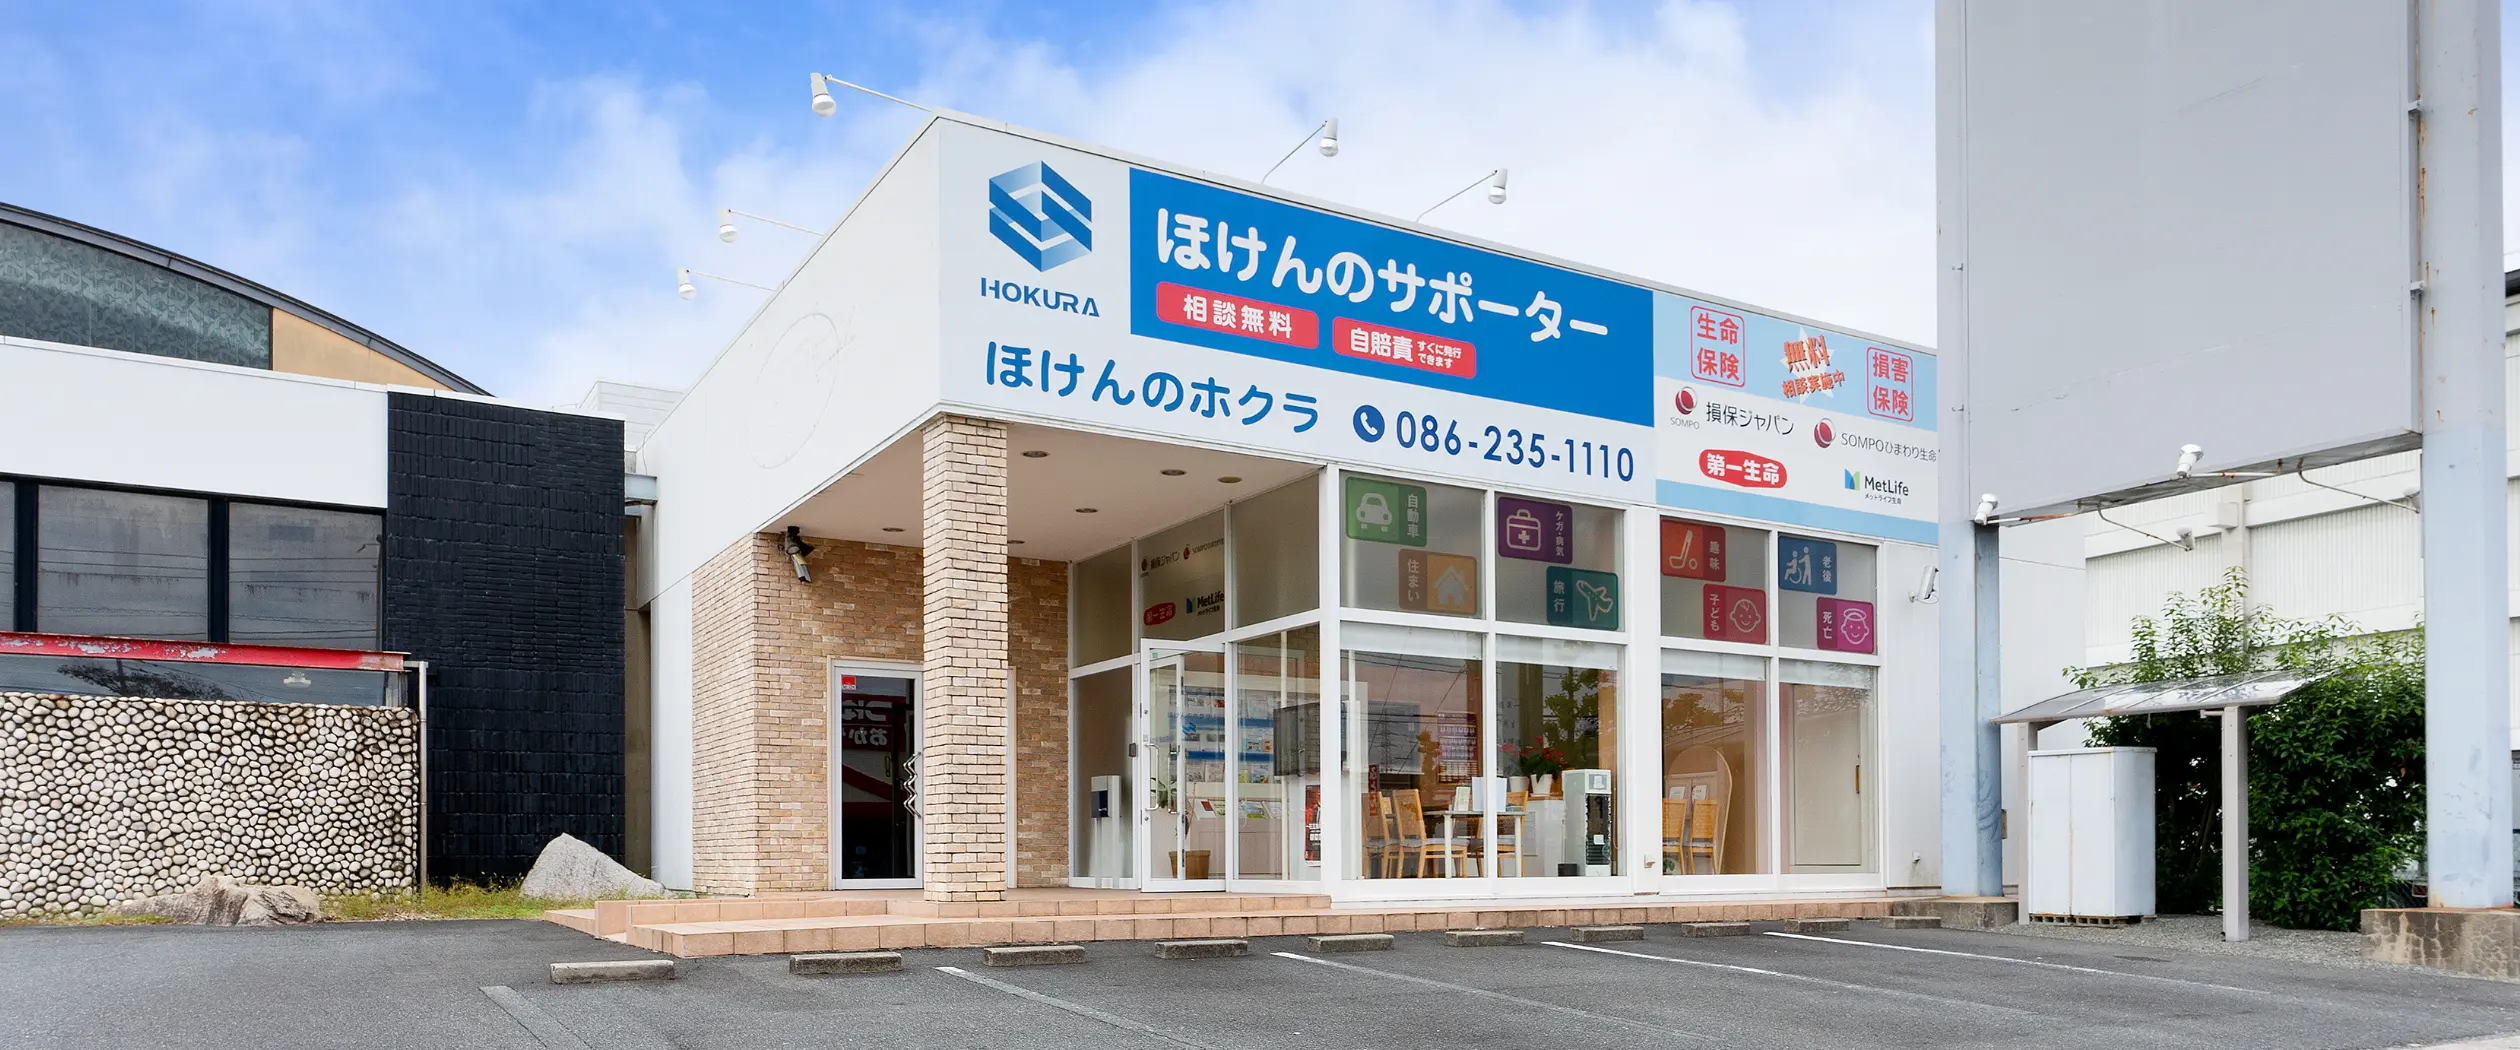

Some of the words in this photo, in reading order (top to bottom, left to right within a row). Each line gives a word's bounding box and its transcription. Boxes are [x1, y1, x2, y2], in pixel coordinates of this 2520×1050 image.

[1157, 208, 1608, 343] ほけんのサポーター
[981, 277, 1100, 317] HOKURA
[1183, 293, 1293, 339] 相談無料
[1697, 312, 1739, 345] 生命
[1351, 327, 1413, 362] 自賠責
[1417, 353, 1453, 369] できます
[1784, 334, 1830, 374] 無料
[1697, 347, 1740, 382] 保険
[1872, 352, 1909, 384] 損害
[986, 341, 1318, 433] ほけんのホクラ
[1782, 369, 1845, 398] 相談実施中
[1872, 384, 1909, 417] 保険
[1670, 417, 1700, 430] SOMPO
[1706, 401, 1794, 435] 損保ジャパン
[1396, 410, 1634, 482] 086-235-1110
[1706, 452, 1779, 485] 第一生命
[1864, 475, 1909, 496] MetLife
[1407, 493, 1420, 538] 自動車
[1555, 511, 1565, 557] ケガ・病気
[1709, 540, 1720, 571] 趣味
[1822, 555, 1832, 583] 老後
[1407, 559, 1420, 602] 住まい
[1553, 579, 1565, 613] 旅行
[1196, 591, 1225, 609] MetLife
[1709, 593, 1720, 632] 子ども
[1822, 611, 1833, 640] 死亡
